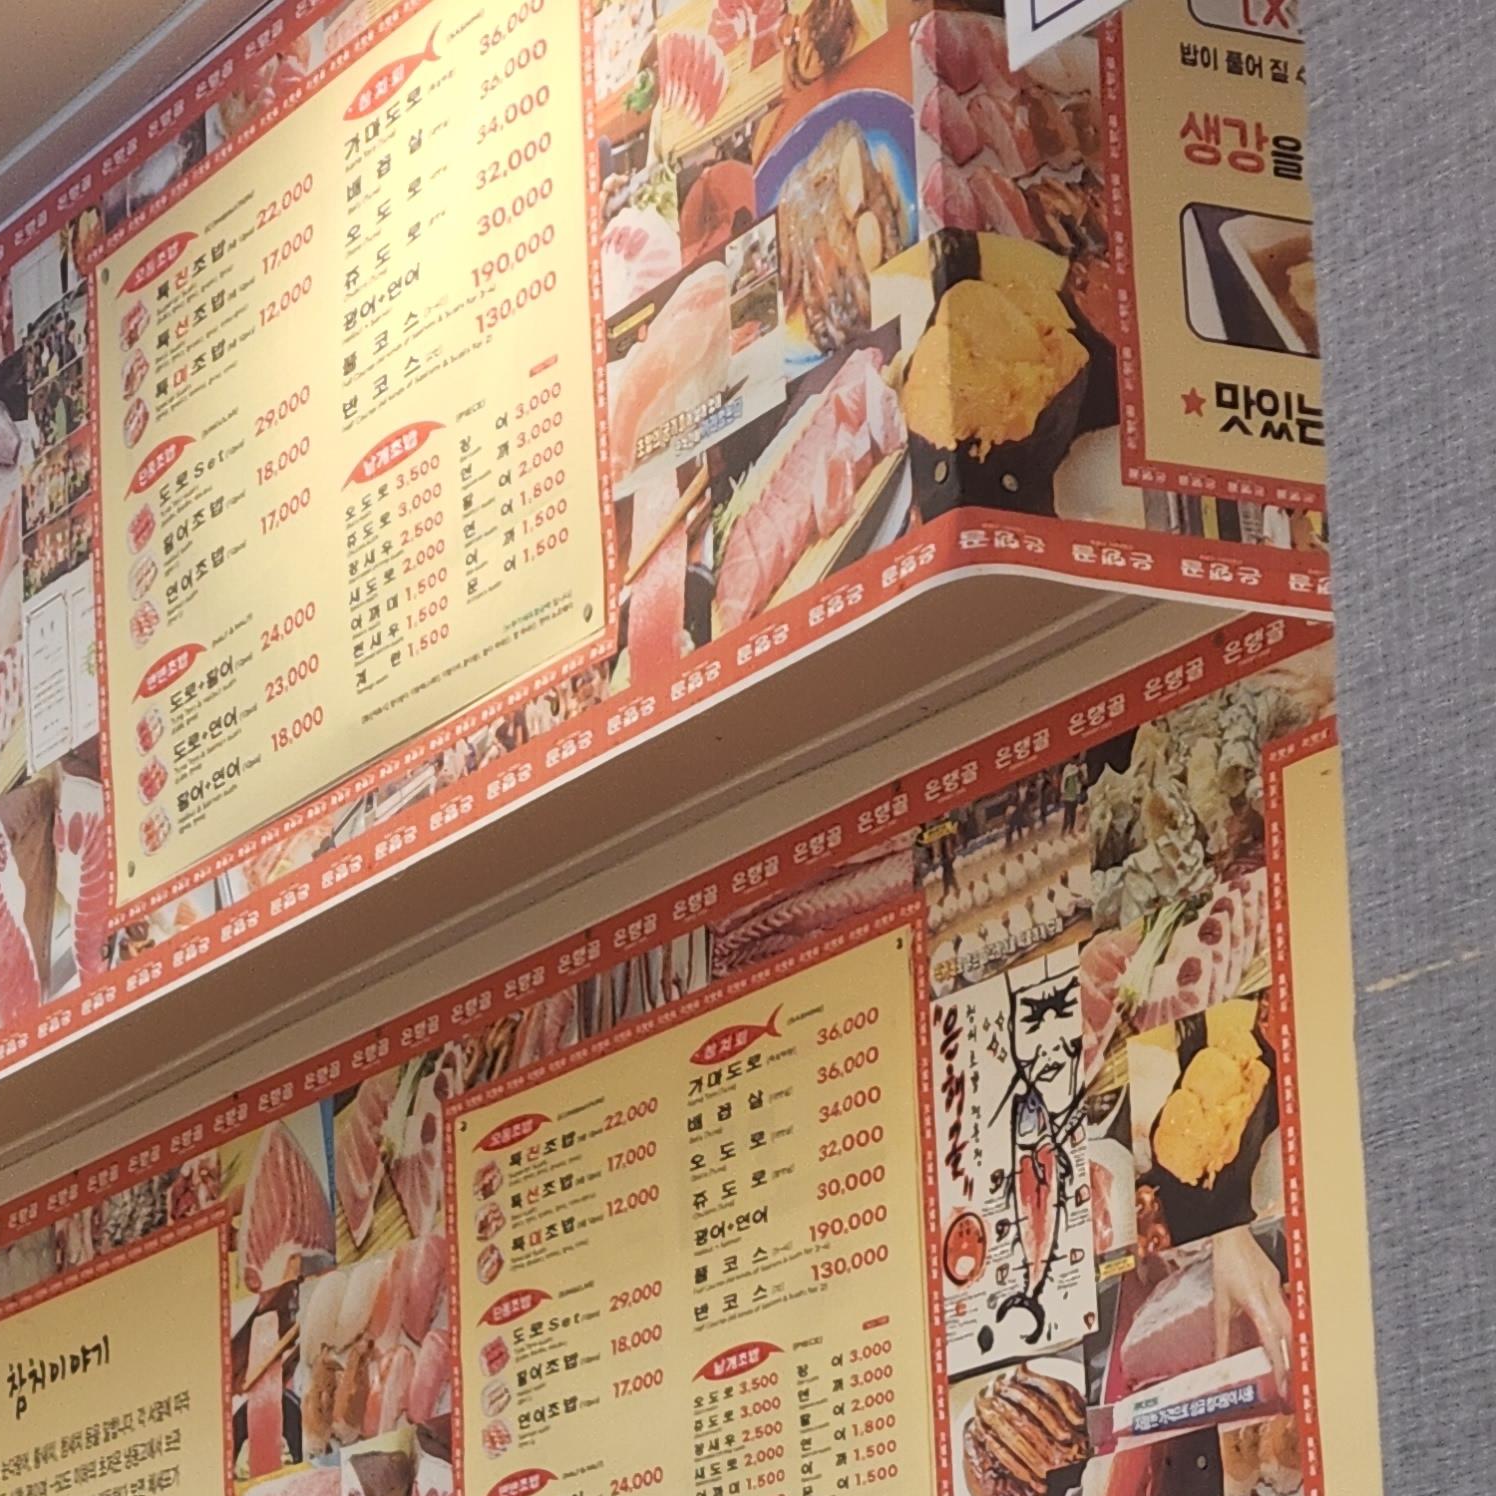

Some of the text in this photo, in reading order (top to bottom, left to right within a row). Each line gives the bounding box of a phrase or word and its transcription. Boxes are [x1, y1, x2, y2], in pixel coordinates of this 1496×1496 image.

[480, 0, 543, 56] 36,000
[480, 39, 547, 100] 36,000
[1180, 41, 1218, 71] 밥이
[477, 85, 550, 145] 34,000
[476, 132, 551, 190] 32,000
[1180, 111, 1304, 181] 생강을
[257, 173, 313, 230] 22,000
[478, 178, 553, 236] 30,000
[262, 224, 313, 274] 17,000
[472, 224, 555, 288] 190,000
[260, 275, 312, 327] 12,000
[476, 271, 556, 333] 130,000
[255, 385, 310, 437] 29,000
[515, 382, 561, 420] 3,000
[517, 411, 563, 448] 3,000
[257, 436, 310, 486] 18,000
[396, 454, 440, 490] 3,500
[519, 440, 564, 477] 2,000
[398, 483, 442, 517] 3,000
[520, 469, 565, 506] 1,800
[261, 487, 310, 535] 17,000
[523, 498, 567, 534] 1,500
[398, 511, 443, 555] 2,500
[523, 527, 568, 563] 1,500
[403, 539, 445, 574] 2,000
[405, 567, 447, 601] 1,500
[261, 601, 315, 651] 24,000
[406, 595, 448, 629] 1,500
[408, 623, 449, 657] 1,500
[265, 654, 319, 702] 23,000
[271, 706, 323, 752] 18,000
[817, 1007, 879, 1045] 36,000
[817, 1046, 879, 1084] 36,000
[605, 1097, 658, 1131] 22,000
[819, 1085, 881, 1123] 34,000
[607, 1141, 656, 1172] 17,000
[819, 1125, 883, 1162] 32,000
[607, 1184, 659, 1217] 12,000
[817, 1165, 885, 1200] 30,000
[807, 1205, 887, 1252] 190,000
[811, 1244, 888, 1281] 130,000
[609, 1280, 662, 1312] 29,000
[611, 1324, 662, 1355] 18,000
[850, 1340, 892, 1363] 3,000
[7, 1335, 110, 1419] 참치이야기
[613, 1368, 663, 1398] 17,000
[740, 1372, 778, 1395] 3,500
[850, 1364, 893, 1388] 3,000
[740, 1396, 781, 1419] 3,000
[851, 1389, 894, 1412] 2,000
[740, 1421, 783, 1448] 2,500
[852, 1414, 895, 1437] 1,800
[744, 1445, 784, 1467] 2,000
[854, 1440, 896, 1461] 1,500
[610, 1466, 663, 1496] 24,000
[746, 1469, 785, 1490] 1,500
[855, 1464, 898, 1486] 1,500
